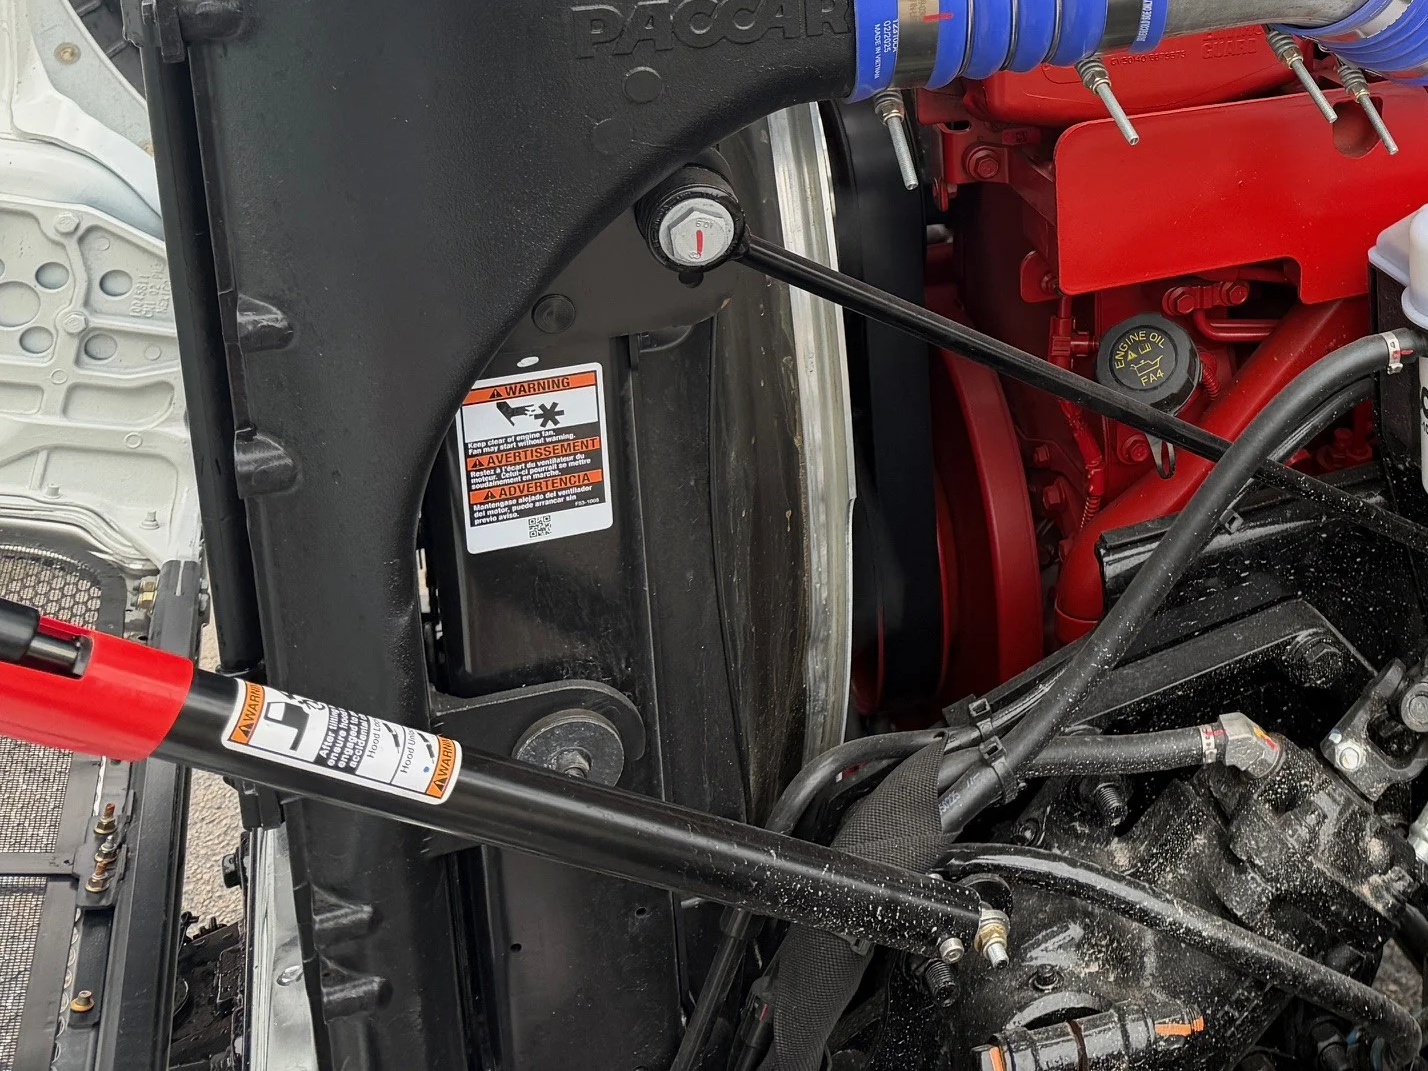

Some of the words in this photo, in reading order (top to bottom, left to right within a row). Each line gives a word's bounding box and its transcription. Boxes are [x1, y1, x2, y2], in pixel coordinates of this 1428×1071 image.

[1115, 331, 1146, 369] ENGINE
[1149, 332, 1165, 349] OIL
[505, 378, 570, 396] WARNING
[1141, 369, 1164, 386] FA4
[468, 441, 486, 449] Keep
[516, 432, 540, 441] engine
[483, 446, 498, 454] may
[518, 438, 545, 447] without
[546, 433, 576, 443] warning.
[487, 438, 597, 467] AVERTISSEMENT
[471, 470, 494, 478] Restez
[537, 456, 575, 468] ventilateur
[471, 475, 498, 483] moteur.
[530, 464, 557, 475] pourrait
[568, 458, 591, 467] mettre
[471, 478, 521, 490] soudainement
[533, 470, 561, 479] marche.
[499, 473, 590, 498] ADVERTENCIA
[473, 499, 516, 511] Mantengase
[518, 494, 544, 505] alejado
[558, 485, 592, 496] ventilador
[512, 502, 534, 512] puede
[535, 497, 564, 507] arrancar
[475, 516, 497, 525] previo
[319, 739, 335, 758] After
[327, 730, 346, 766] ensure
[338, 709, 349, 728] hood
[338, 725, 358, 767] engaged
[350, 721, 368, 768] accidental
[367, 733, 380, 759] Hood
[400, 746, 415, 773] Hood
